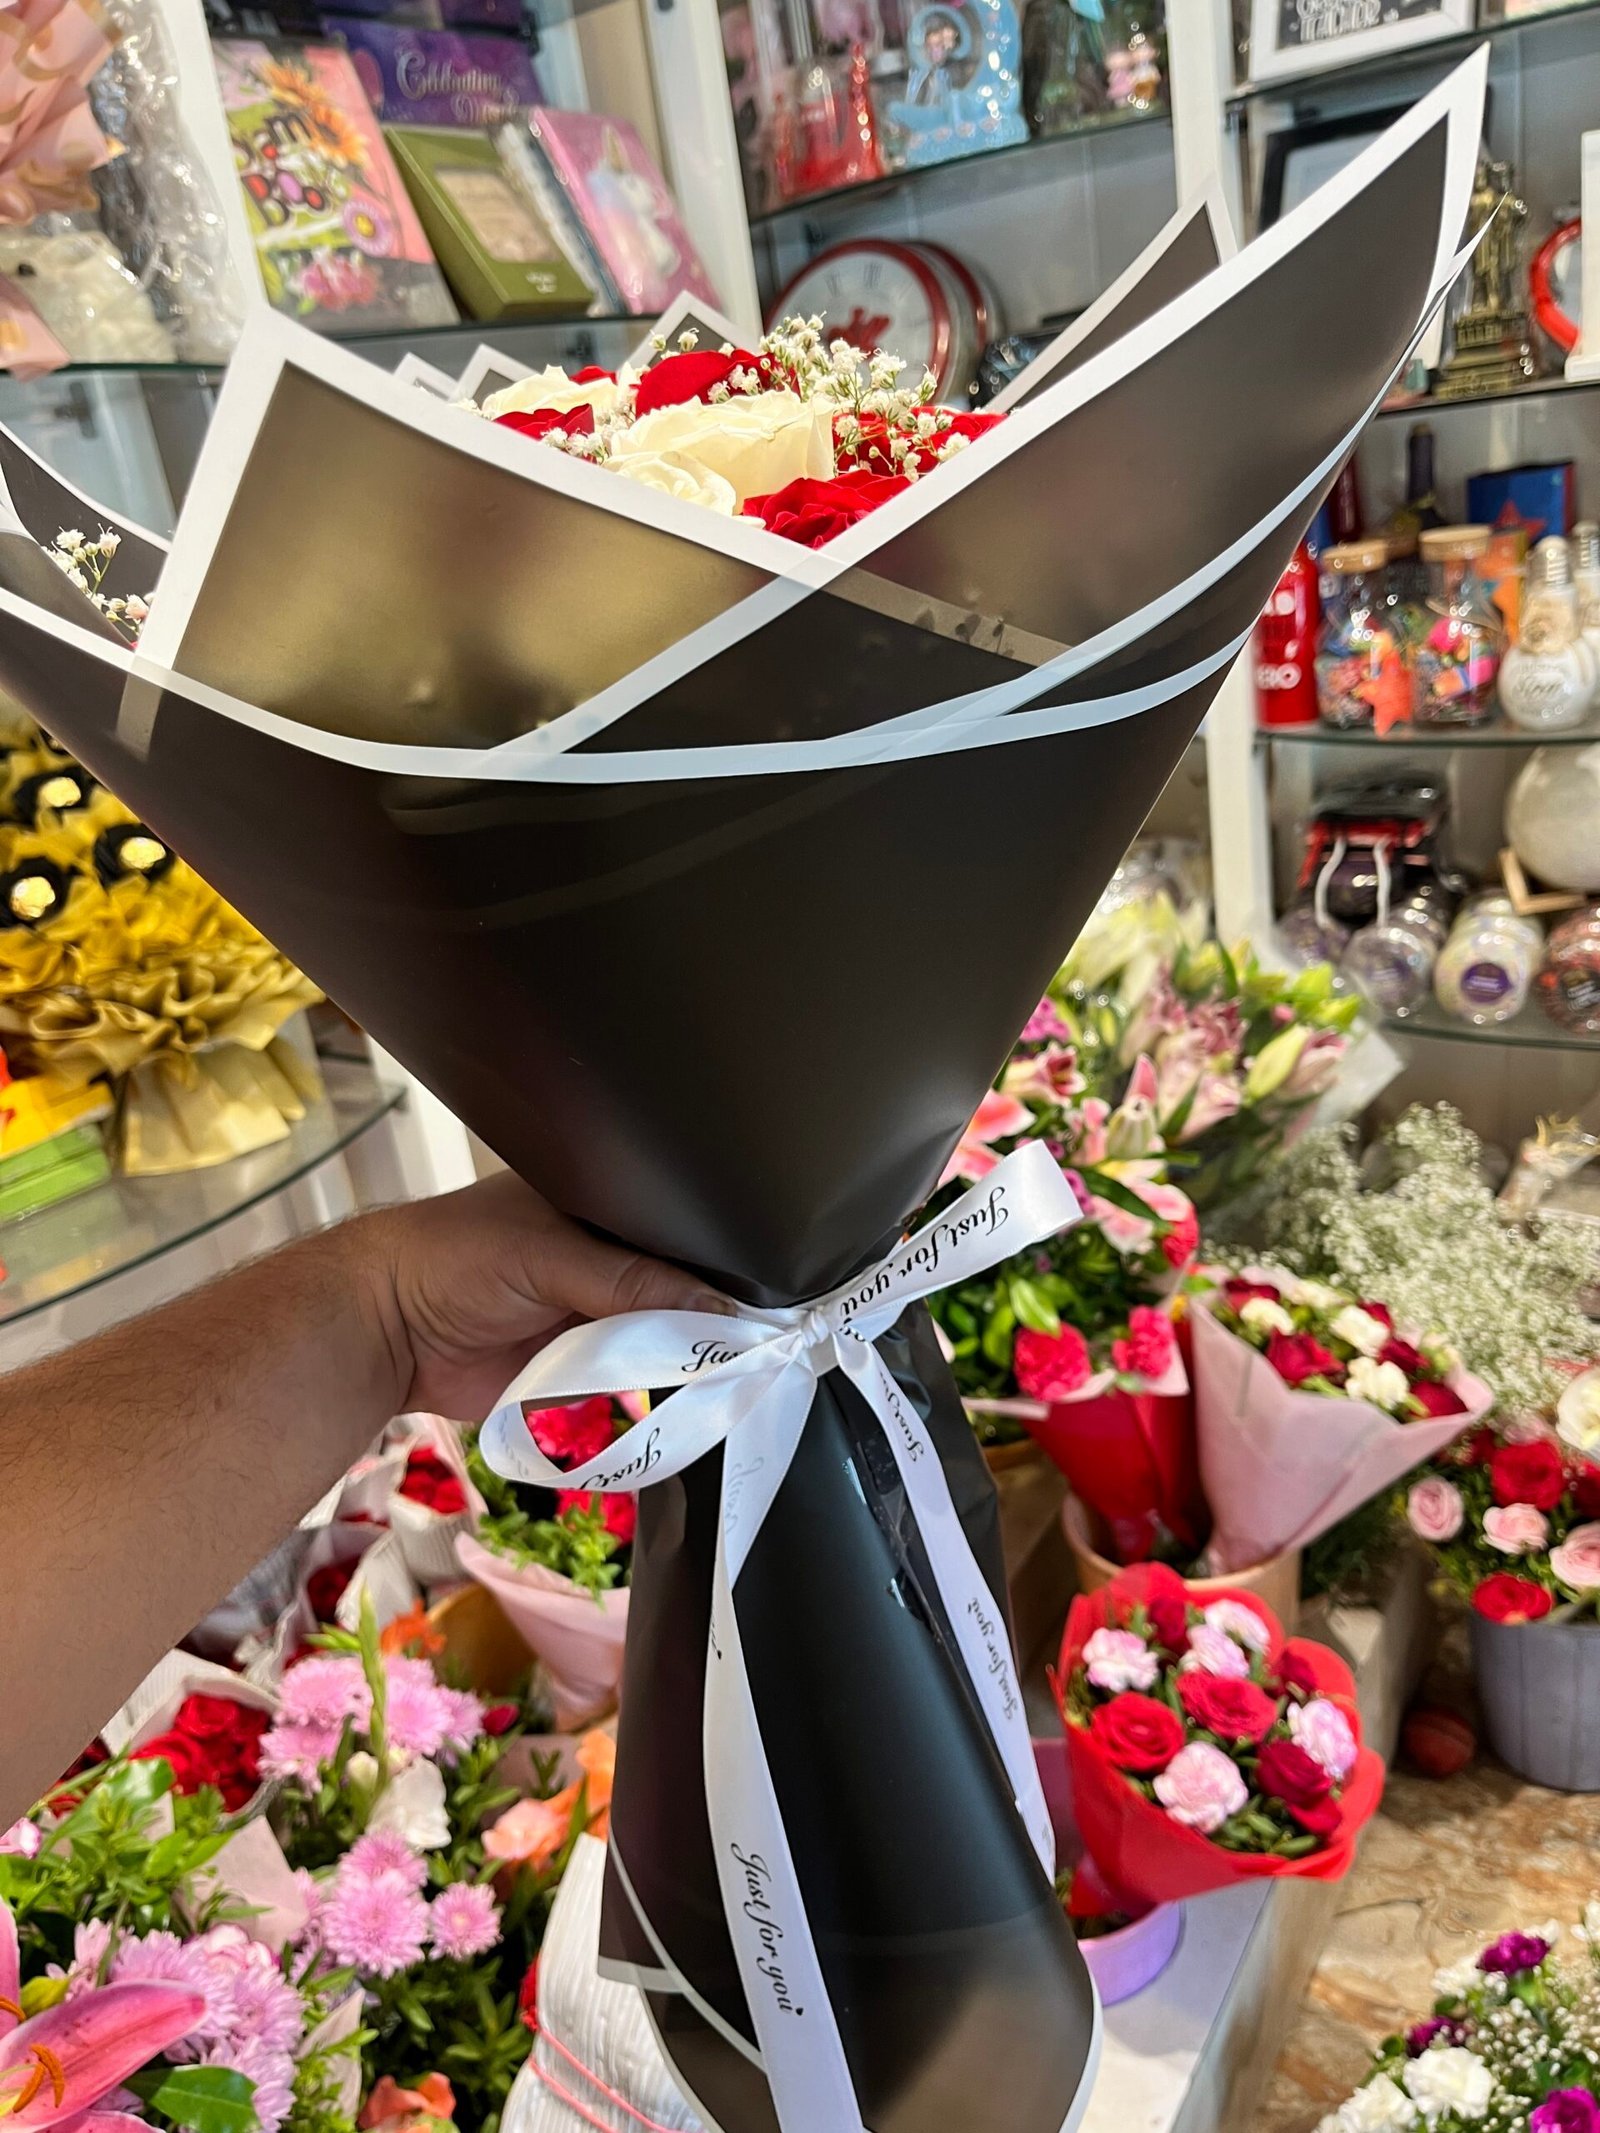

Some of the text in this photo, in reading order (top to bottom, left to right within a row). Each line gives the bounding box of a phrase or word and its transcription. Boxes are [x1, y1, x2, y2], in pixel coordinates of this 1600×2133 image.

[840, 1186, 1009, 1316] Just for you
[894, 1404, 925, 1463] Just
[971, 1597, 1018, 1720] Just for you
[731, 1842, 793, 2013] Just for you
